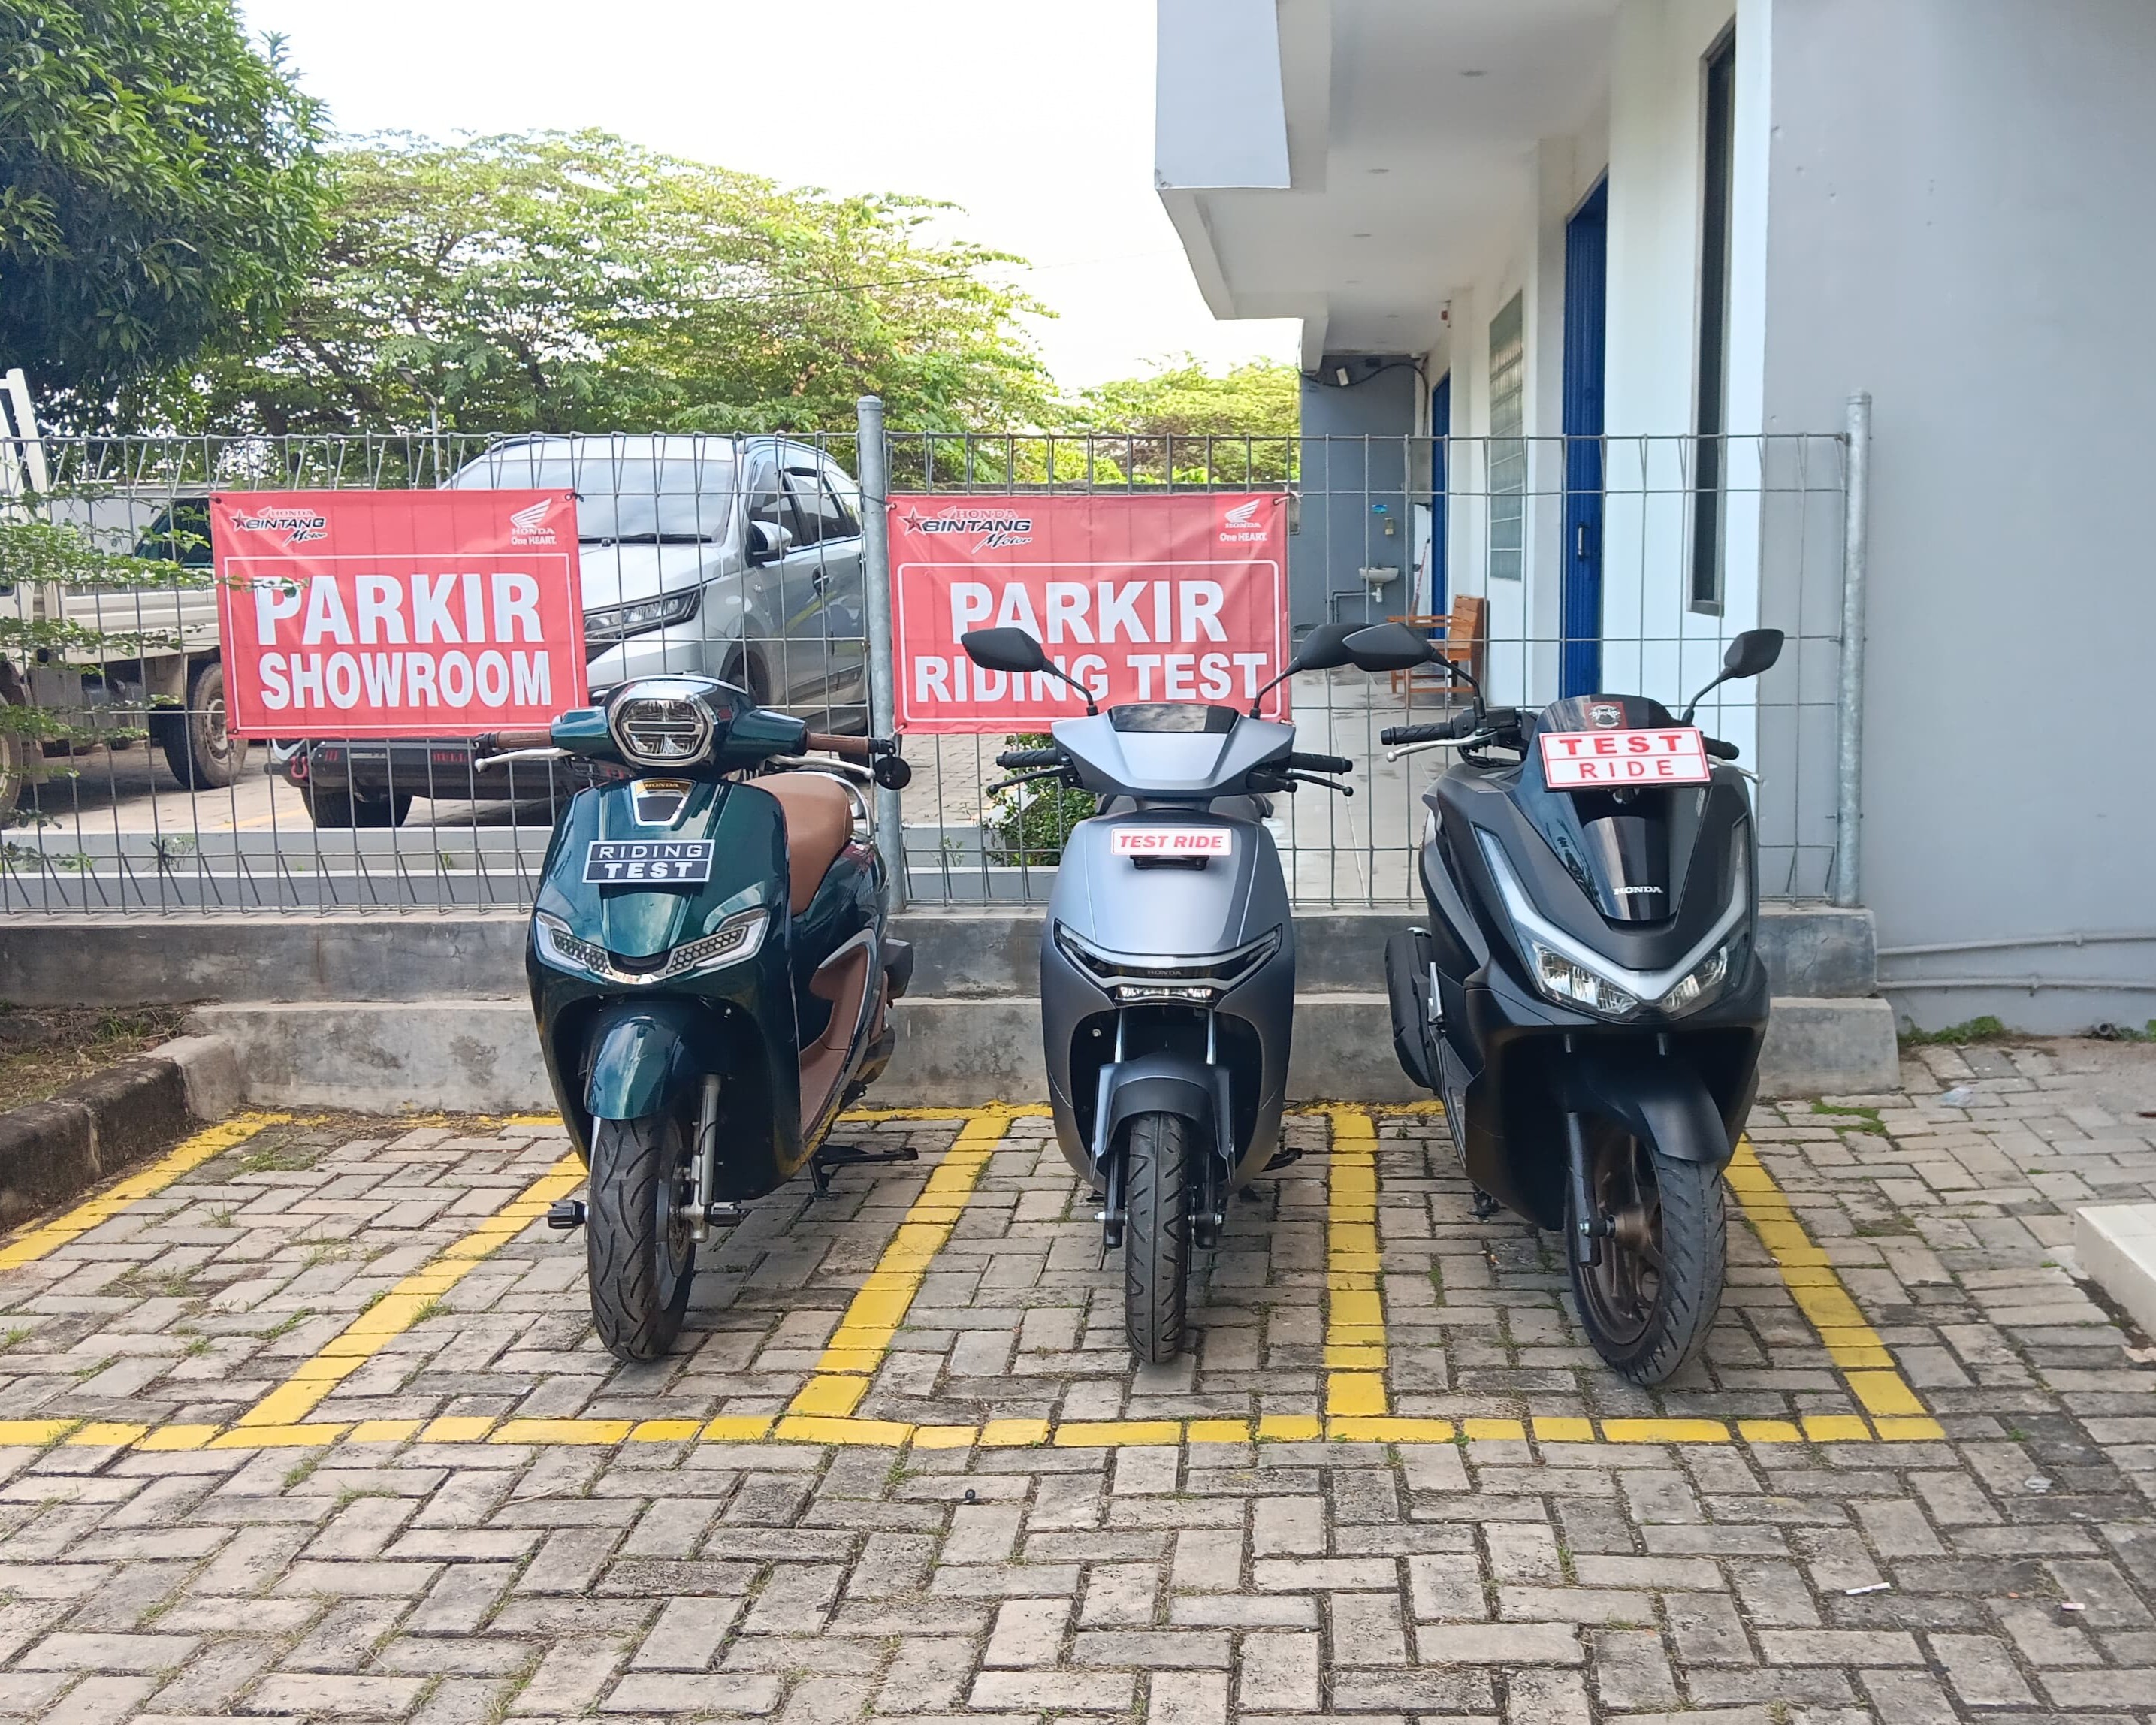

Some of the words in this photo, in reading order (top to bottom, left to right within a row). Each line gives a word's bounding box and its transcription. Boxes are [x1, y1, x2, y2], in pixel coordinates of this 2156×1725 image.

[956, 510, 1015, 518] HONDA
[246, 518, 325, 529] BINTANG
[922, 520, 1031, 532] BINTANG
[512, 536, 527, 545] One
[973, 533, 1032, 551] Motor
[1220, 532, 1237, 542] One
[255, 573, 544, 645] PARKIR
[950, 581, 1228, 644] PARKIR
[259, 651, 552, 710] SHOWROOM
[914, 654, 1108, 703] RIDING
[1127, 653, 1267, 701] TEST
[1559, 735, 1682, 755] TEST
[1579, 760, 1674, 779] RIDE
[1120, 835, 1169, 848] TEST
[1173, 835, 1224, 848] RIDE
[599, 844, 703, 859] RIDING
[605, 862, 693, 878] TEST
[1613, 886, 1663, 896] HONDA
